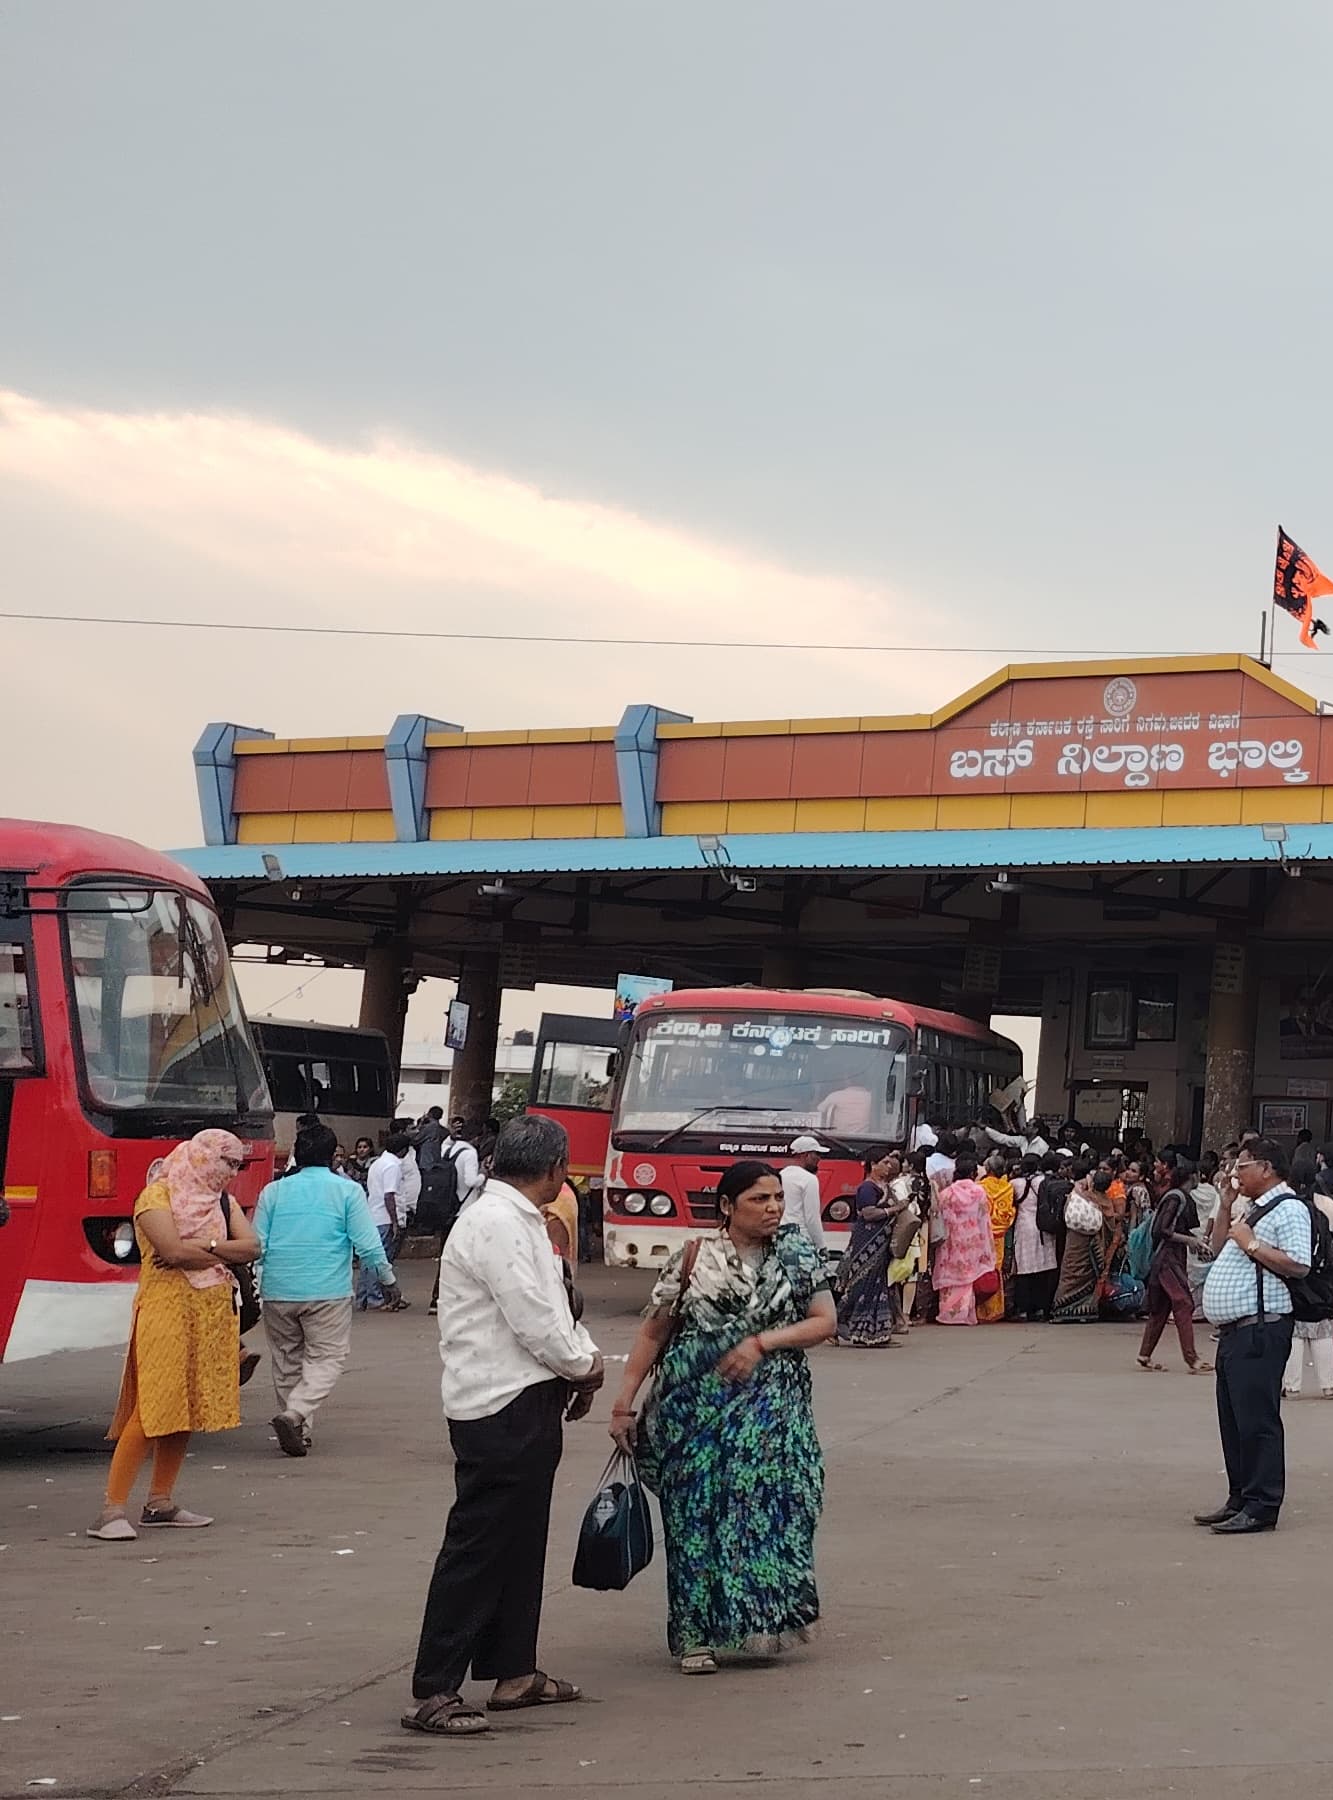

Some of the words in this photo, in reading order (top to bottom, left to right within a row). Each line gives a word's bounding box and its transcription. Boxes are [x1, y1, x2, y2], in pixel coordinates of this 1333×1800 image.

[1026, 717, 1073, 736] ಕರ್ನಾಟಕ
[949, 739, 1035, 778] ಬಸ್
[1056, 742, 1185, 788] ನಿಲ್ದಾಣ
[1208, 739, 1312, 783] ಭಾಲ್ಕಿ
[655, 1019, 722, 1039] ಕಲ್ಯಾಣ
[830, 1027, 892, 1046] ಸಾರಿಗೆ
